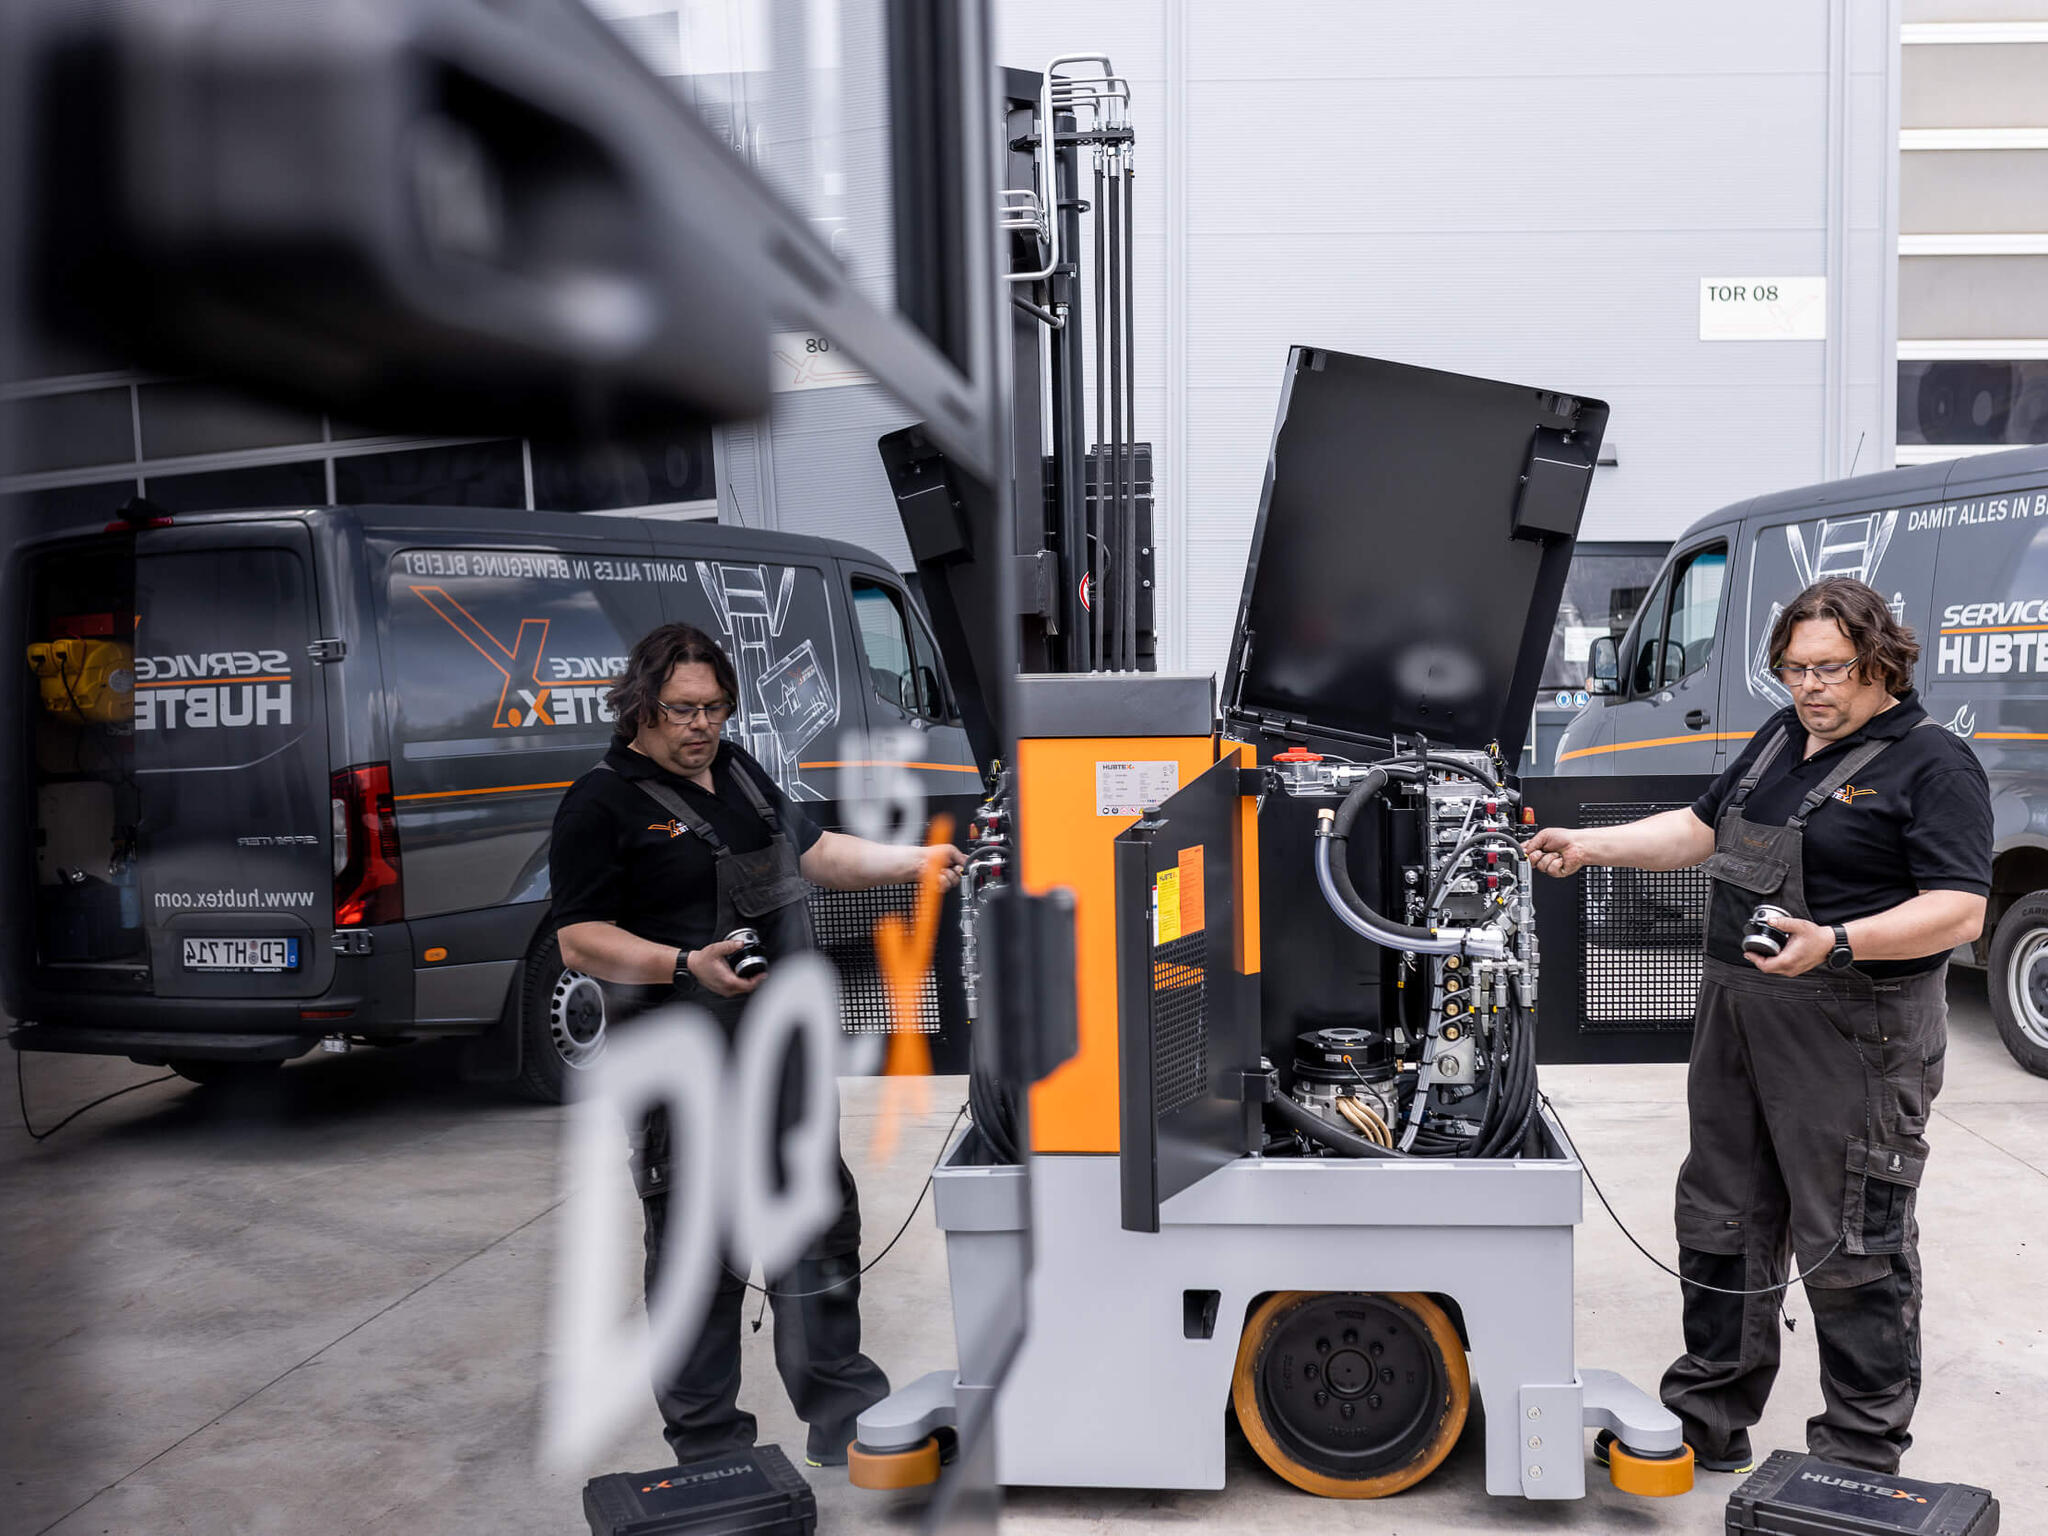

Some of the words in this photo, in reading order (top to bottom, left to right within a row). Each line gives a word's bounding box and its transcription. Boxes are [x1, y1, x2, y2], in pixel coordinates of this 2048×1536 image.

[1707, 285, 1746, 302] TOR
[1753, 285, 1779, 302] 08
[1908, 506, 1957, 531] DAMIT
[1958, 499, 2008, 526] ALLES
[2012, 496, 2031, 519] IN
[2034, 494, 2048, 516] B
